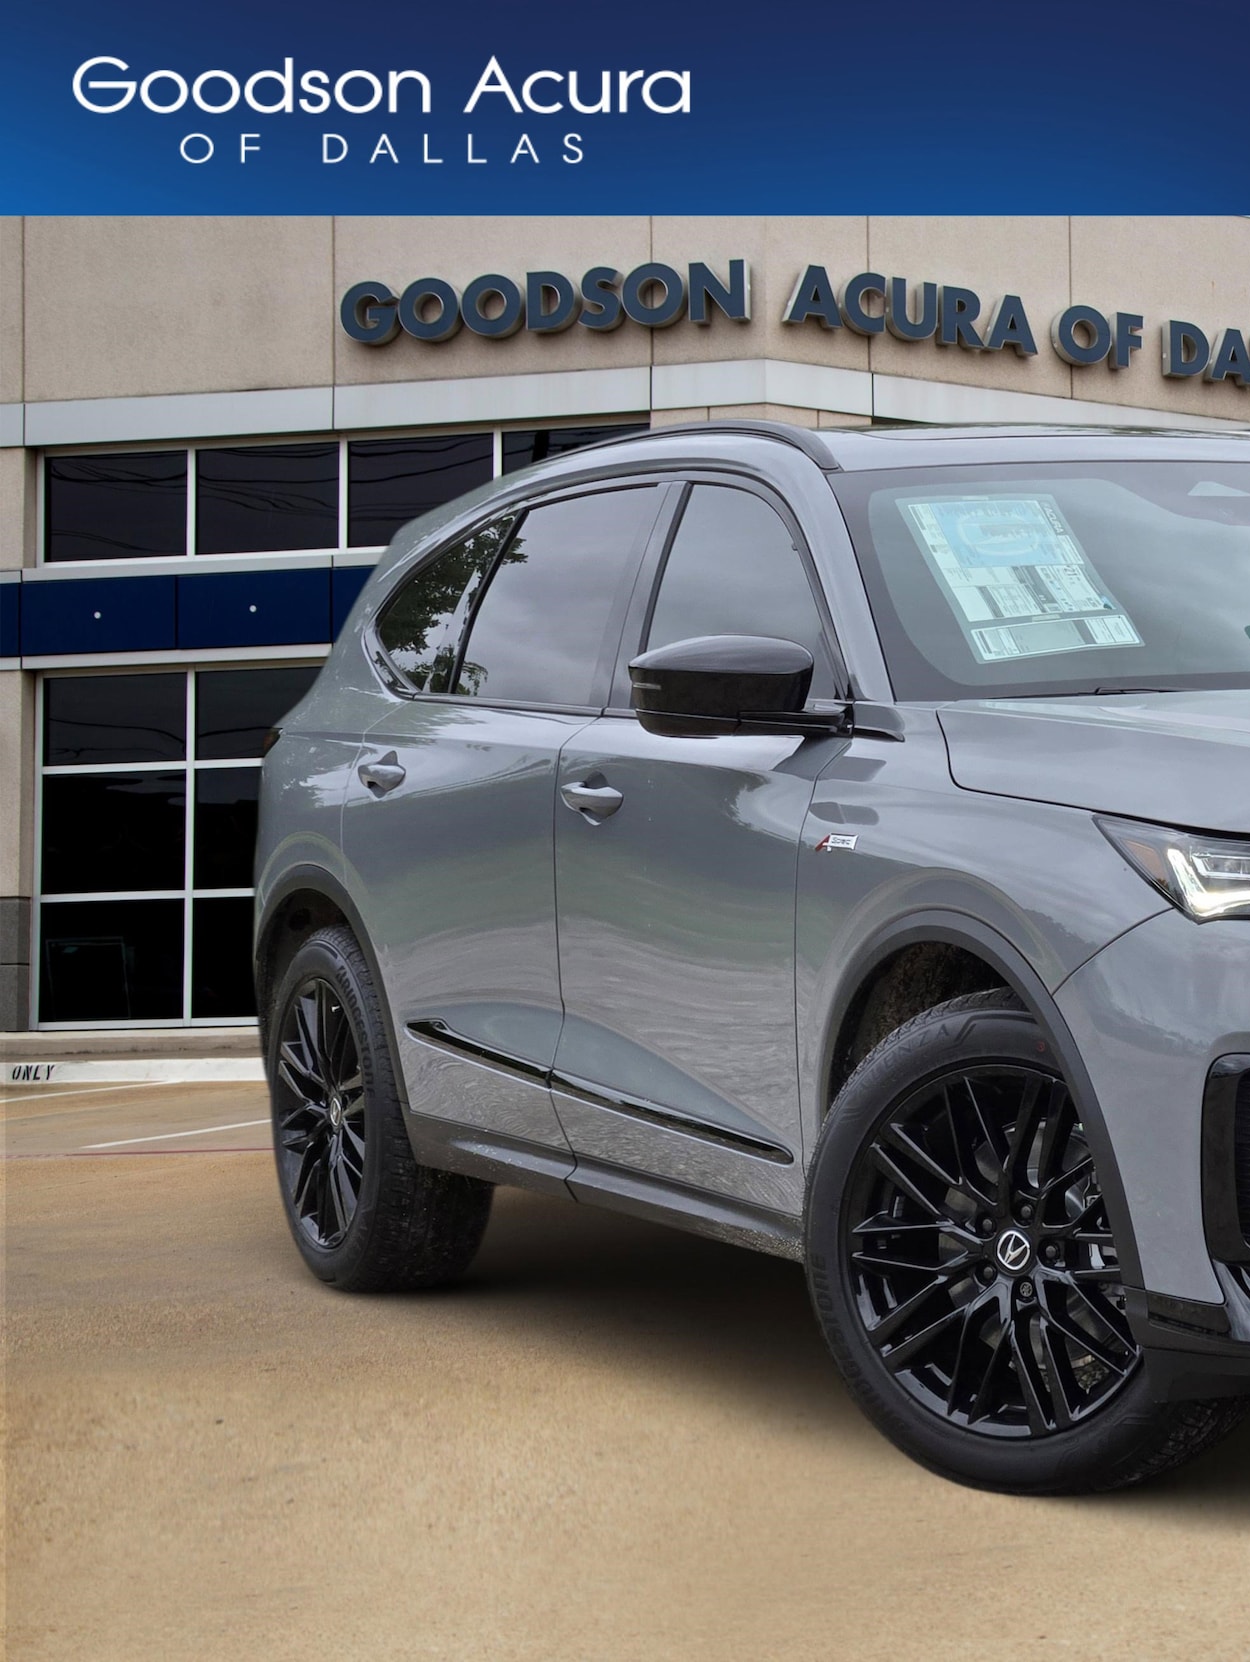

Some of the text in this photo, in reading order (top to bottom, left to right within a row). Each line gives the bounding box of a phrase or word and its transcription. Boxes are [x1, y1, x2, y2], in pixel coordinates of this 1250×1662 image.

[340, 259, 751, 346] GOODSON
[782, 264, 1038, 358] ACURA
[1051, 304, 1144, 371] OF
[11, 1064, 56, 1081] ONLY
